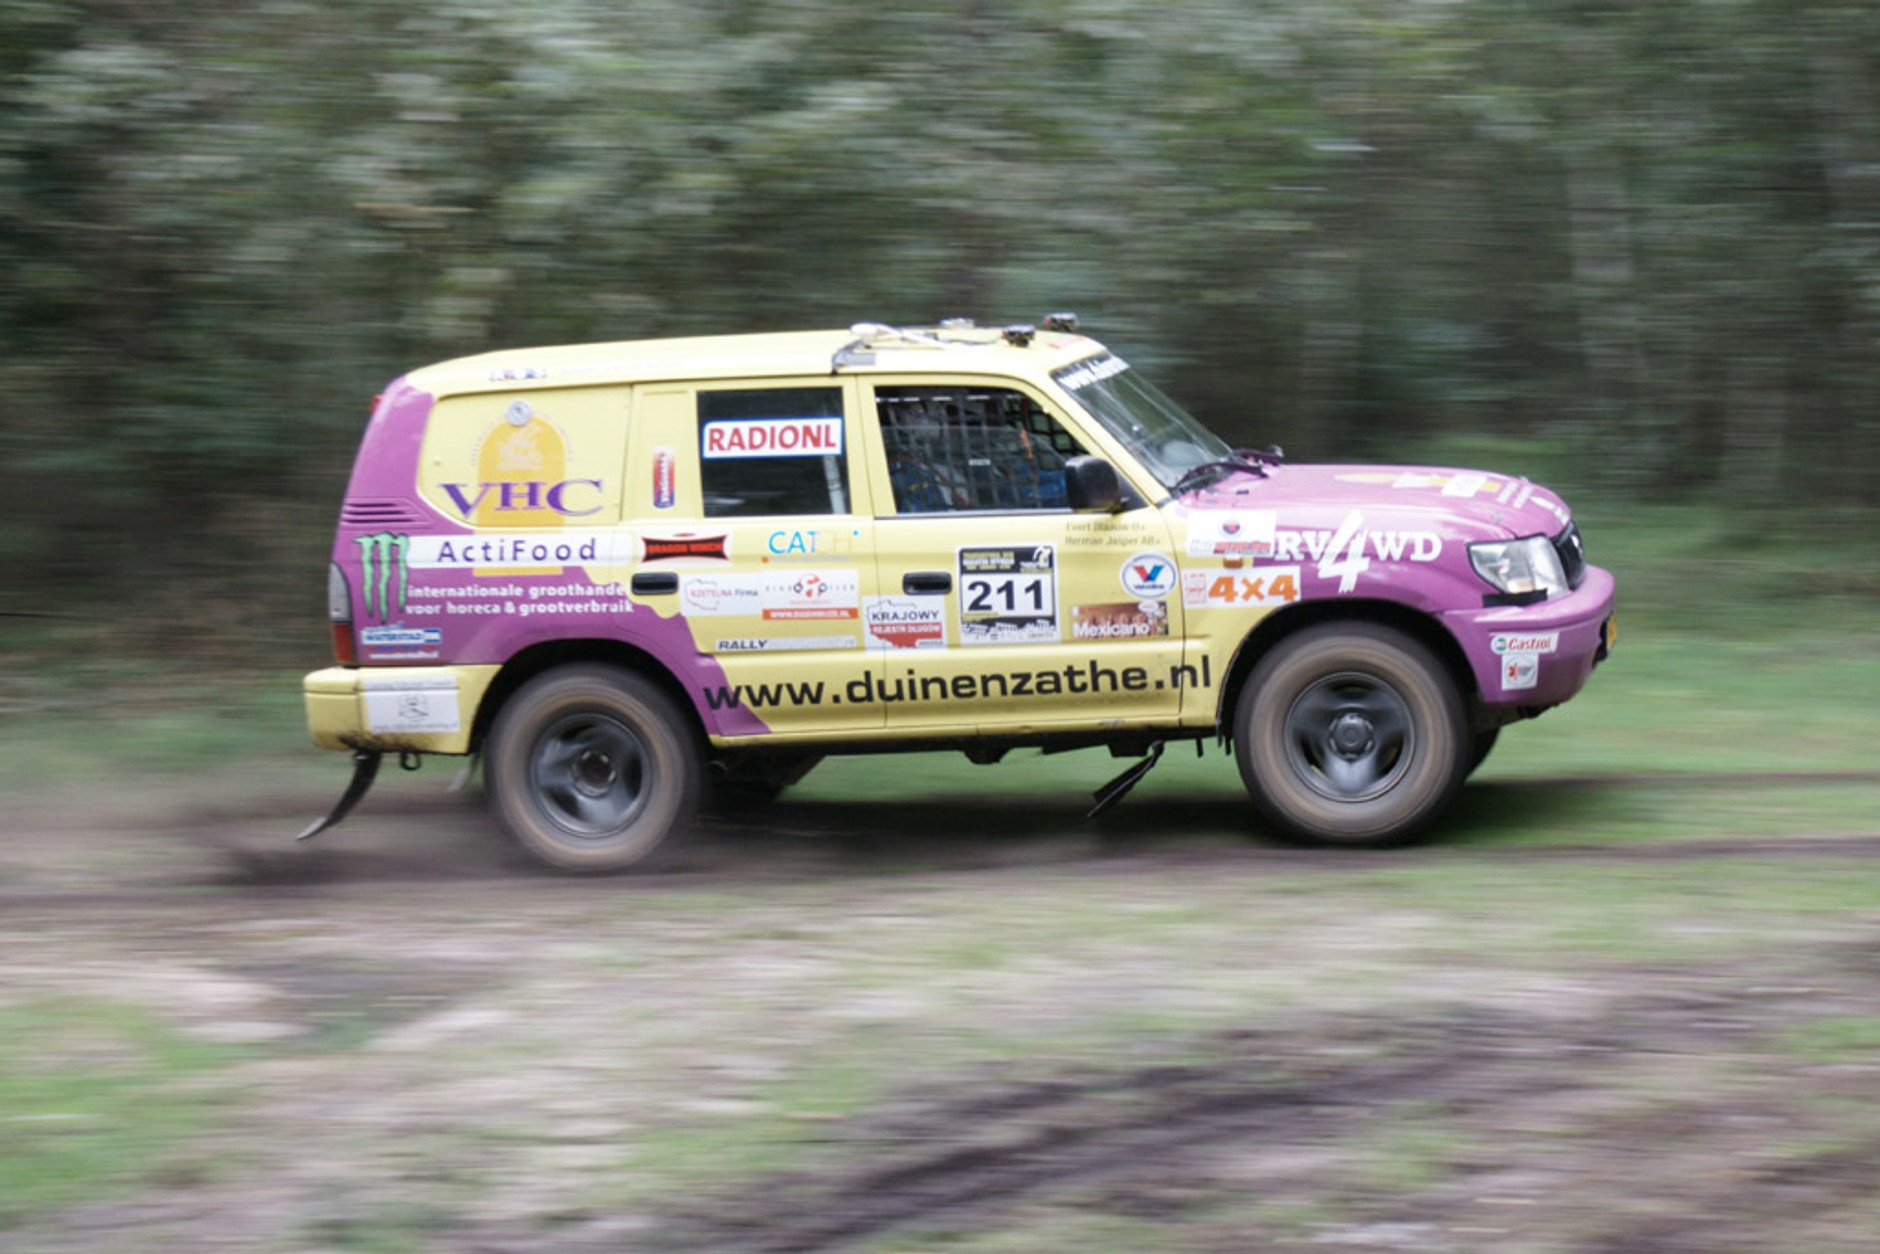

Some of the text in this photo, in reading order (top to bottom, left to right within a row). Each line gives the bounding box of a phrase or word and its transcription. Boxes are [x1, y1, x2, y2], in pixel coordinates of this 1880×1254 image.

[708, 424, 837, 452] RADIONL
[436, 479, 605, 519] VHC
[1065, 536, 1103, 545] Herman
[436, 537, 597, 563] ActiFood
[407, 583, 626, 600] internationale groothande
[967, 579, 1043, 611] 211
[405, 600, 634, 616] voor horeca & grootverbruik
[872, 610, 939, 621] KRAJOWY
[718, 639, 768, 650] RALLY
[1508, 637, 1551, 650] Castrol
[702, 654, 1213, 710] www.duinenzathe.nl
